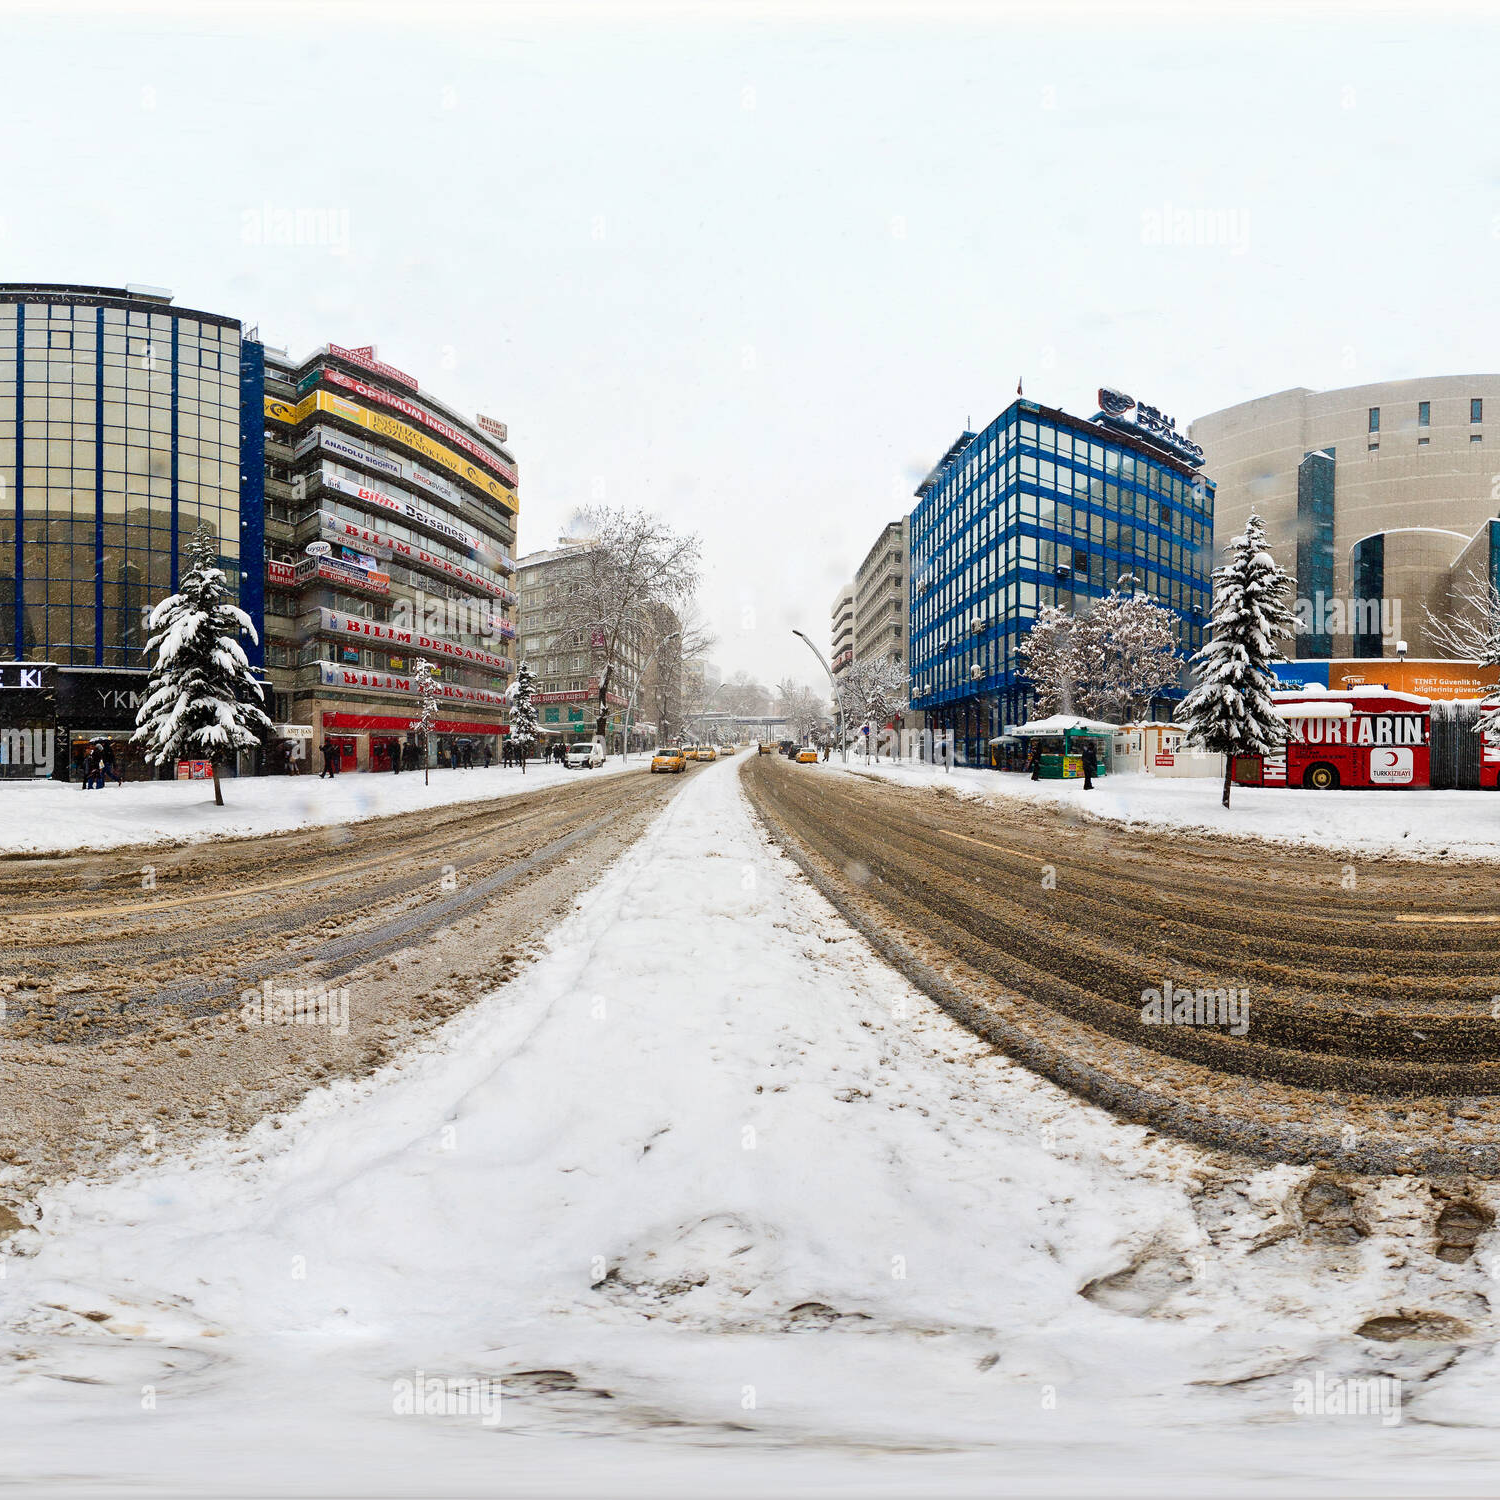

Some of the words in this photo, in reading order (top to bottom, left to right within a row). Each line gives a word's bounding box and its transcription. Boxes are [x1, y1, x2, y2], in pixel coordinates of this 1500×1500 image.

[324, 439, 363, 460] ANADOLU
[270, 563, 293, 576] THY
[1439, 678, 1470, 686] Güvenlik
